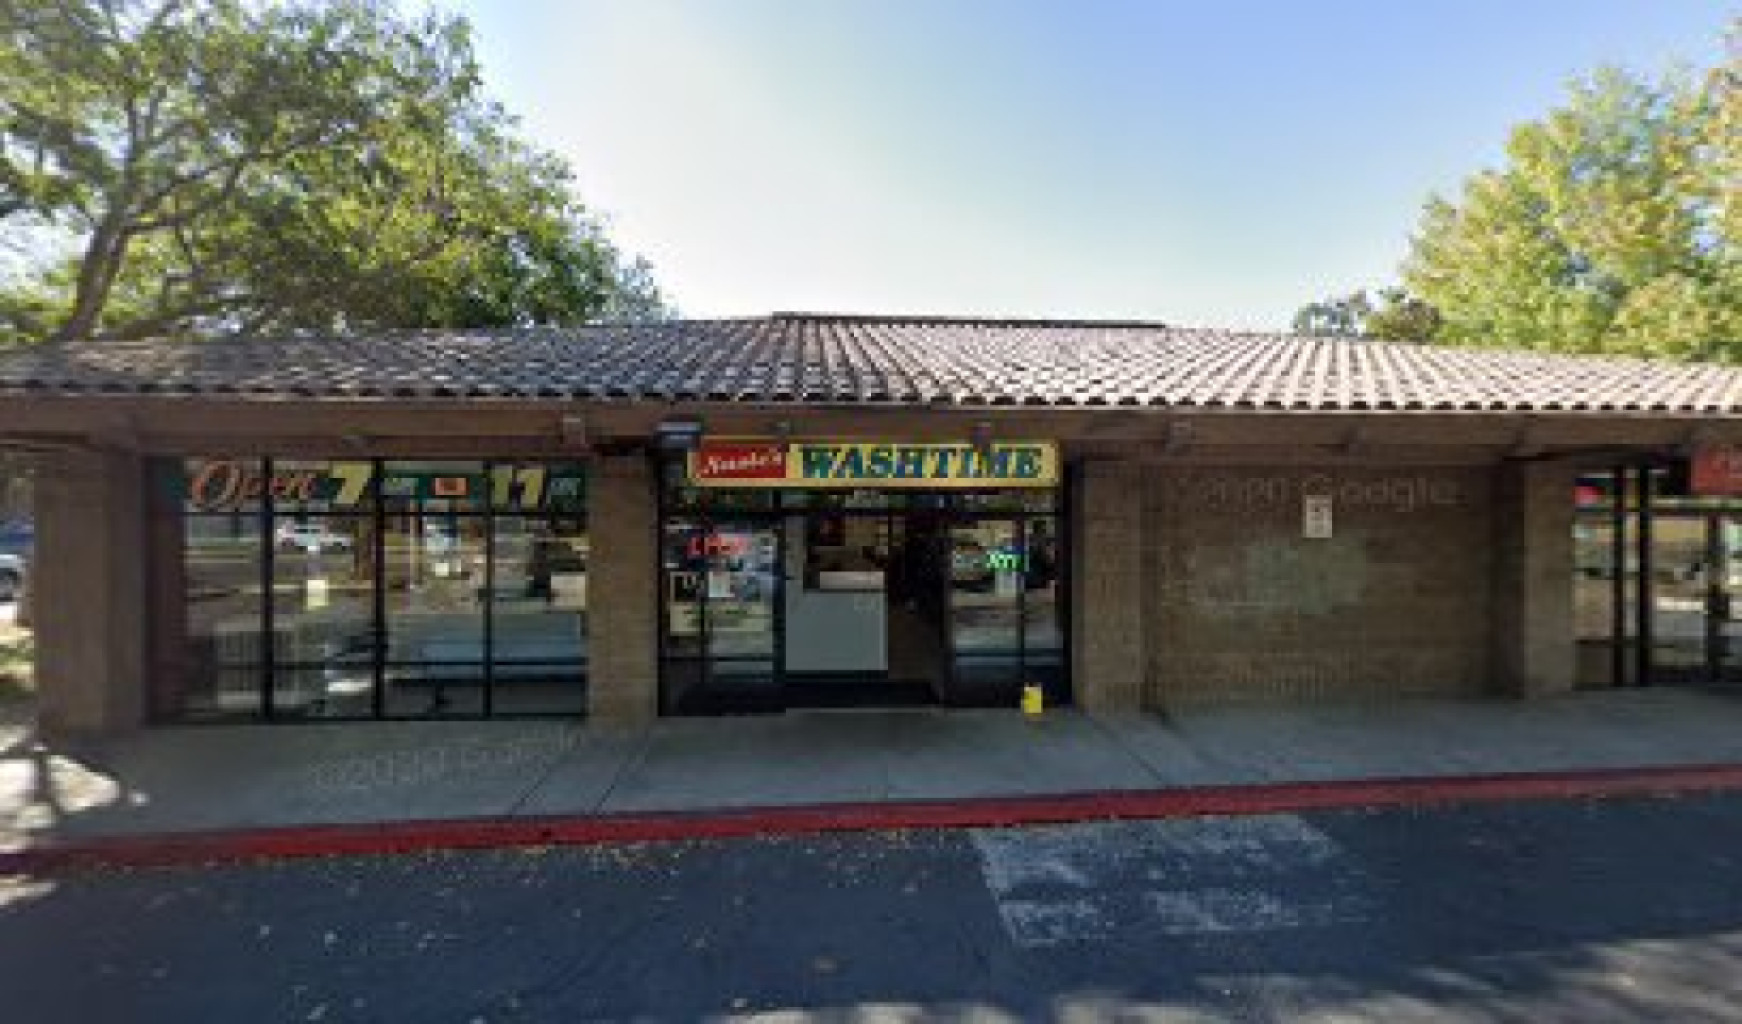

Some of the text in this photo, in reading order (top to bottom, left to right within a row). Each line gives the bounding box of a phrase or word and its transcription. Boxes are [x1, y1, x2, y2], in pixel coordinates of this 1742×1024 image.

[802, 446, 1043, 480] WASHTIME
[327, 461, 373, 506] 7
[491, 463, 547, 506] 11
